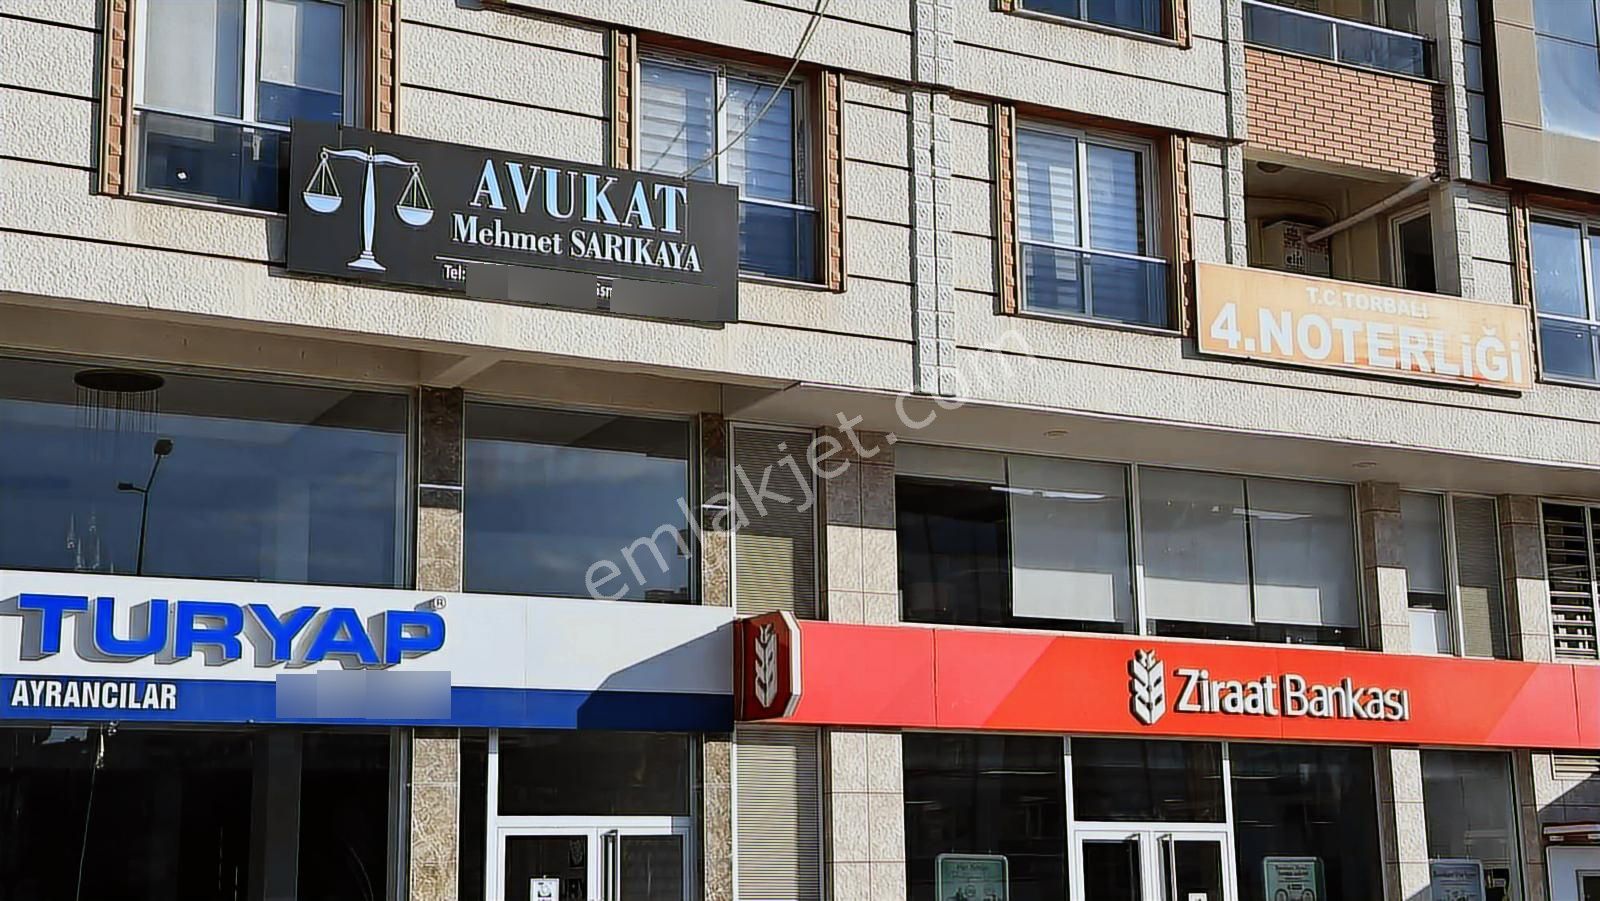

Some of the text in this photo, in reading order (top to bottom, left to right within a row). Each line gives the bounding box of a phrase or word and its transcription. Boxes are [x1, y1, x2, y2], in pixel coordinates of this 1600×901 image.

[470, 158, 687, 234] AVUKAT
[452, 213, 702, 273] Mehmet SARIKAYA
[444, 264, 466, 281] Tel:
[1342, 291, 1429, 318] TORBALI
[16, 592, 447, 667] TURYAP
[11, 679, 177, 711] AYRANCILAR
[1175, 668, 1411, 721] Ziraat Bankası
